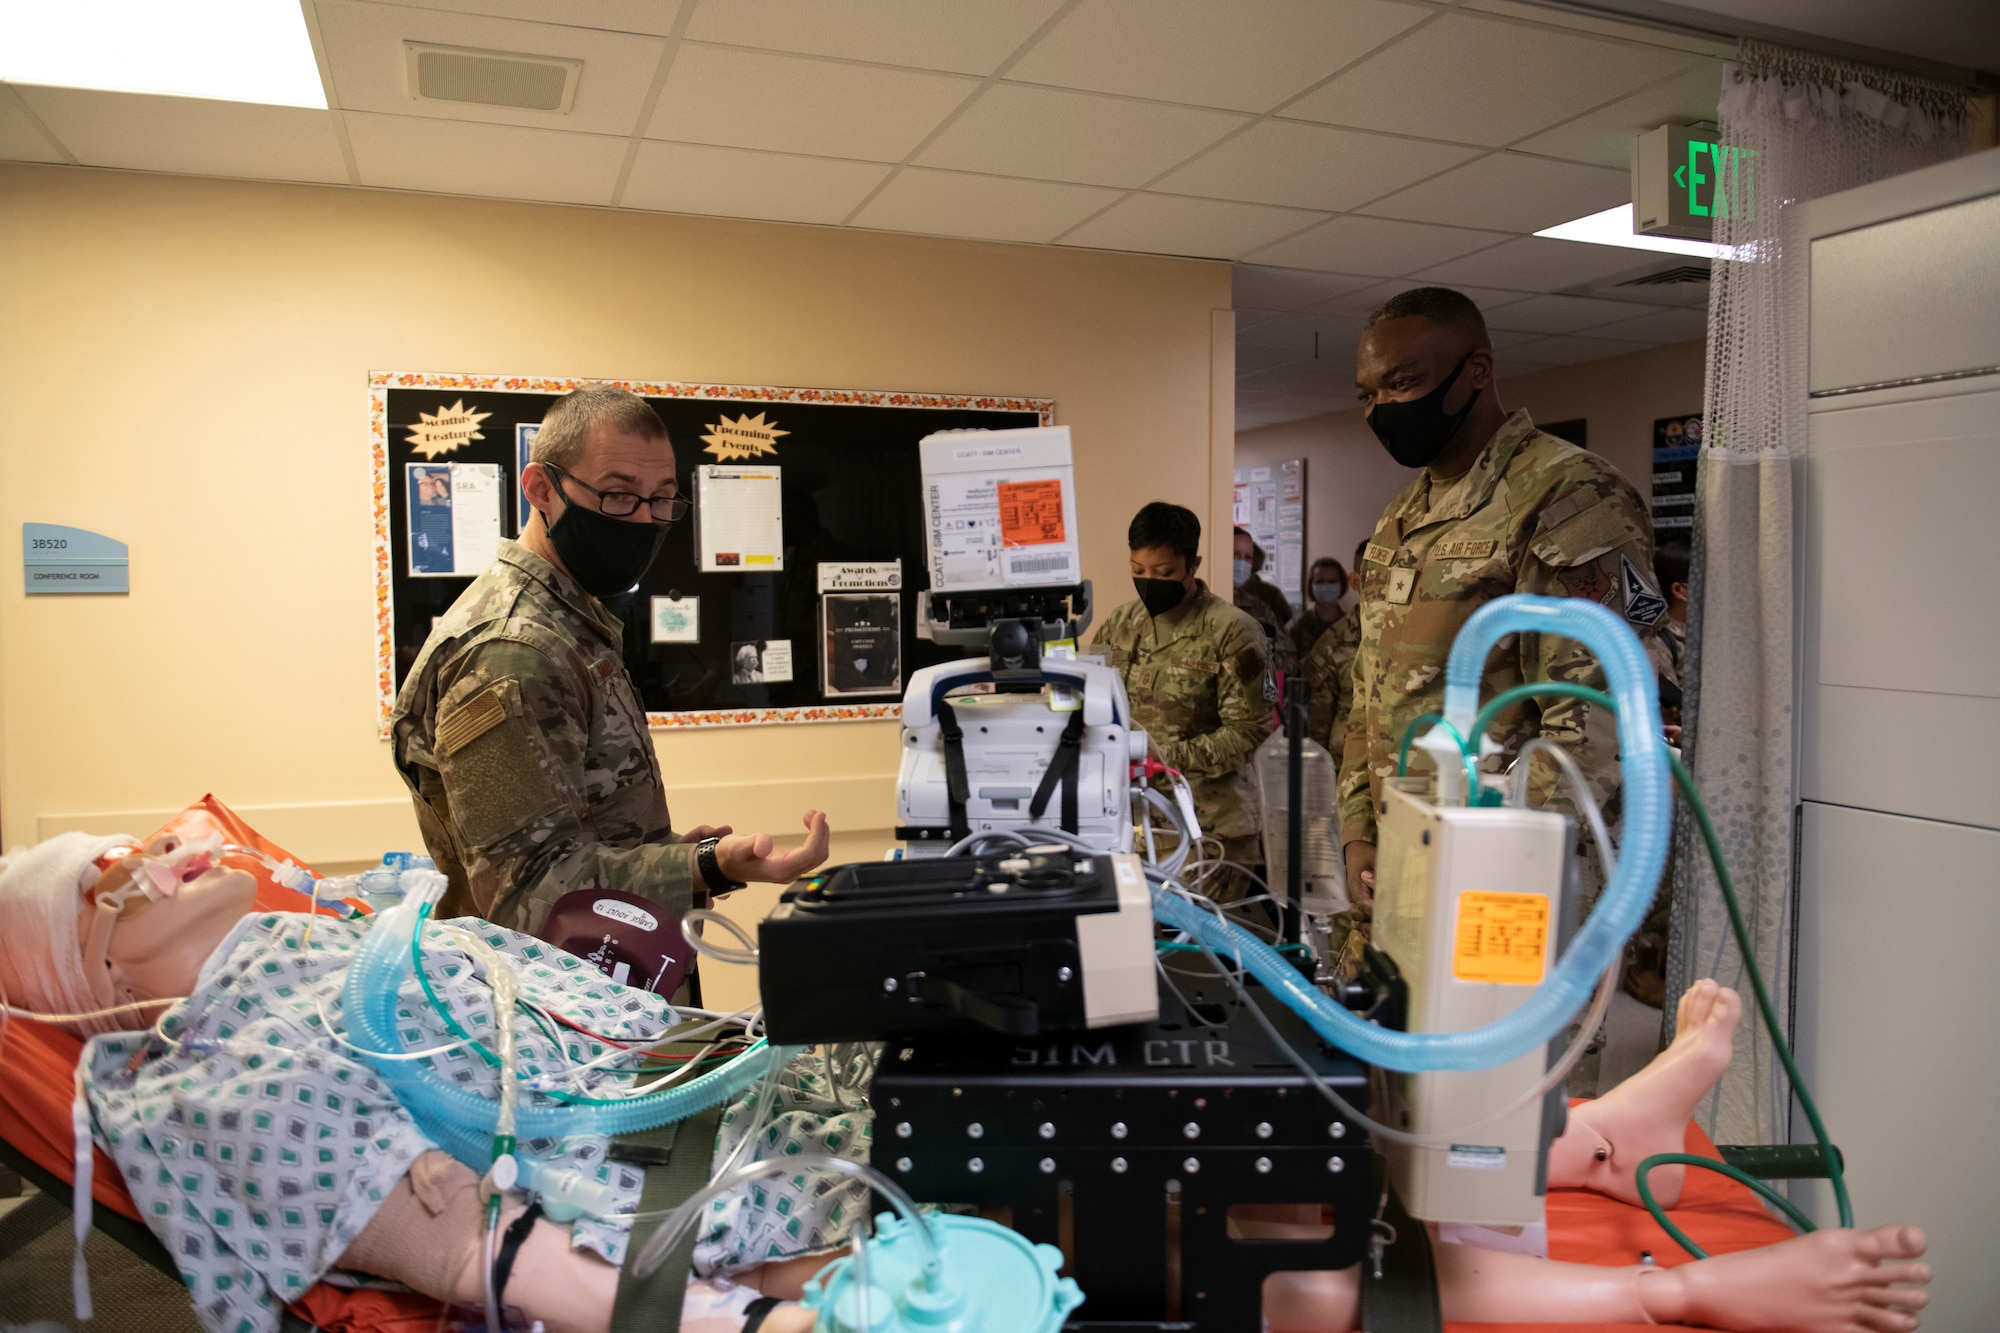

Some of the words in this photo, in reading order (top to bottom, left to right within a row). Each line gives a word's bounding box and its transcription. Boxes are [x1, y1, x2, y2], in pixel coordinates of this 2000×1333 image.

[1688, 140, 1760, 221] EXIT
[424, 416, 471, 427] Monthly
[425, 430, 476, 442] Feature
[713, 424, 771, 440] Upcoming
[722, 440, 760, 452] Events
[995, 447, 1021, 456] CENTER
[455, 482, 476, 490] SRA
[930, 485, 941, 527] CENTER
[32, 539, 68, 549] 3B520
[932, 529, 942, 547] SIM
[1448, 542, 1464, 556] AIR
[1464, 540, 1492, 556] FORCE
[934, 556, 945, 588] CCATT
[596, 903, 605, 911] 12
[606, 908, 629, 919] ADULT
[630, 915, 654, 929] LARGE
[1010, 1042, 1117, 1067] SIM
[1144, 1040, 1235, 1067] CTR
